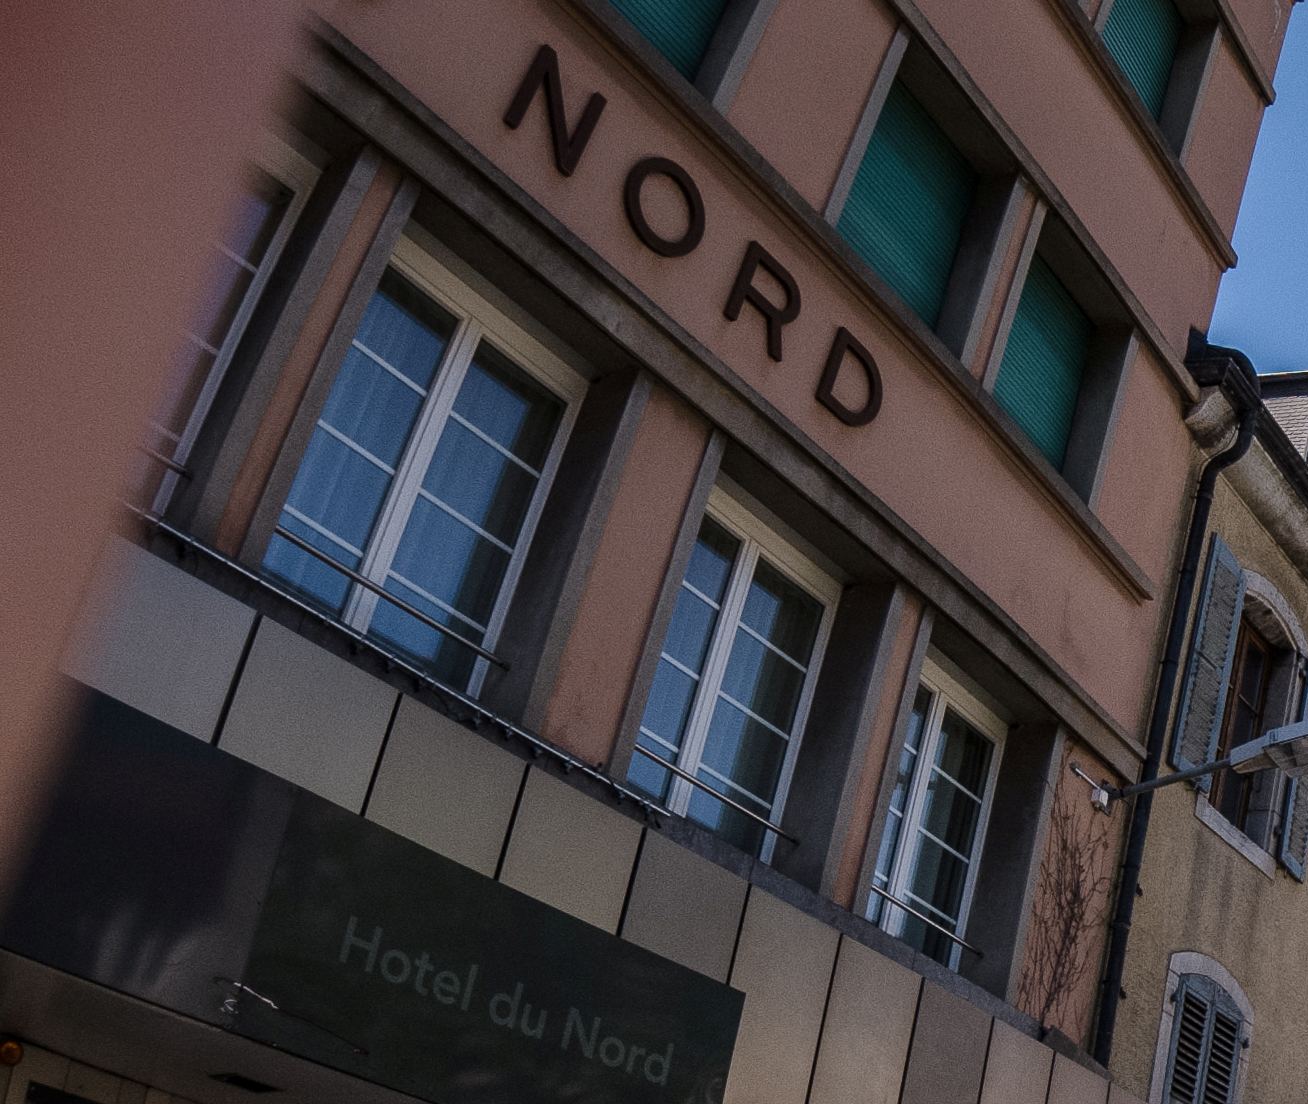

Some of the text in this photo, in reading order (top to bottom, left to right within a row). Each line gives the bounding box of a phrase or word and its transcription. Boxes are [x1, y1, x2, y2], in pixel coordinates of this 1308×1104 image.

[503, 44, 882, 427] NORD
[339, 916, 675, 1086] Hotel du Nord
